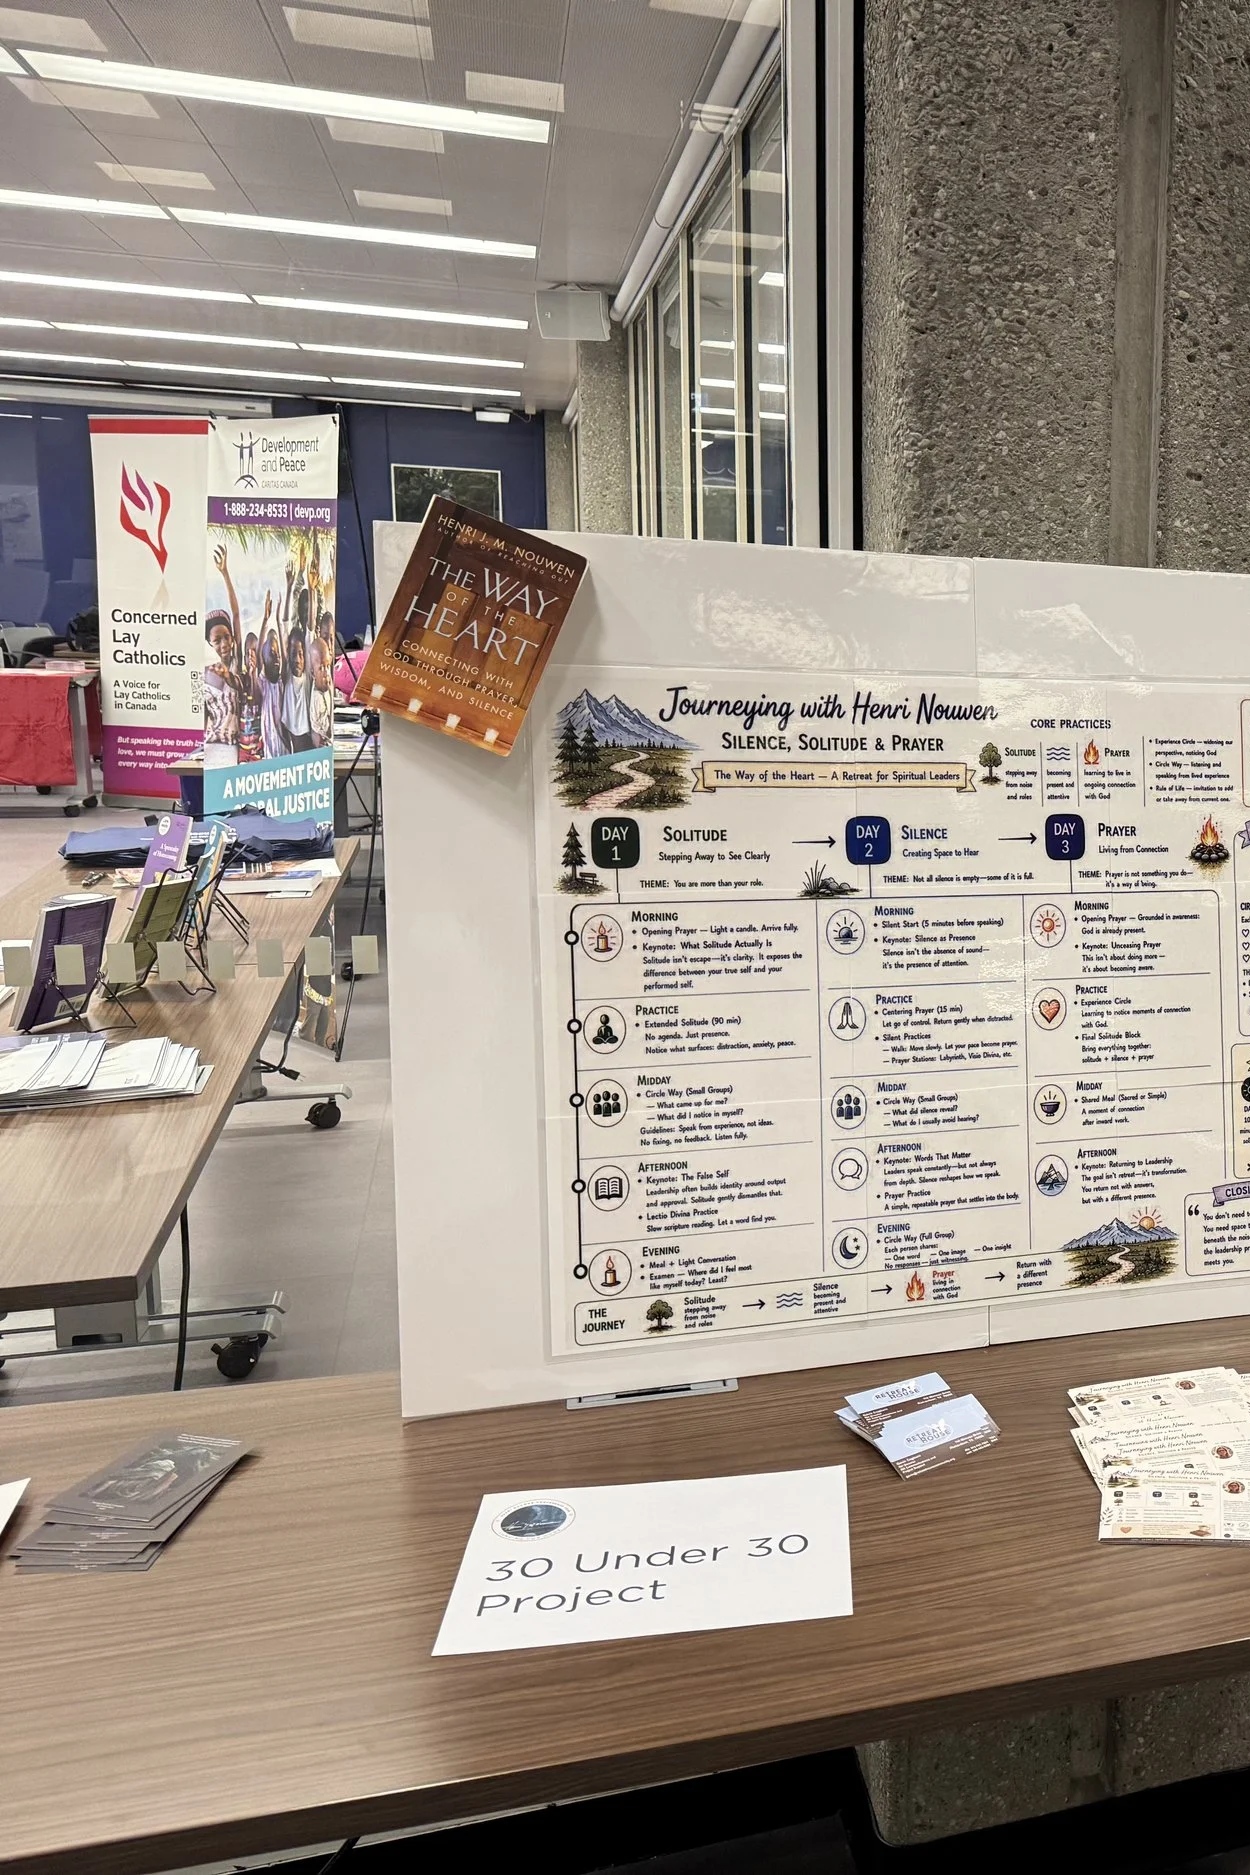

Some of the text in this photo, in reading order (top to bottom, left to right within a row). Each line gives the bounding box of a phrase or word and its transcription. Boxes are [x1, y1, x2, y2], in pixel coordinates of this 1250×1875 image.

[262, 437, 319, 456] Development
[262, 457, 305, 472] and Peace
[224, 503, 330, 522] 1-888-234-8533 devp.org
[438, 514, 575, 578] HENRI J. M. NOUWEN
[438, 528, 474, 545] AUTHOR
[498, 552, 544, 575] REACHING
[552, 574, 569, 584] OUT
[429, 556, 559, 620] THE WAY
[447, 592, 516, 626] OF THE
[112, 609, 197, 625] Concerned
[404, 595, 540, 666] HEART
[113, 629, 140, 647] Lay
[113, 650, 186, 666] Catholics
[402, 639, 514, 689] CONNECTING WITH
[384, 648, 518, 707] GOD THROUGH PRAYER,
[114, 680, 120, 688] A
[148, 681, 160, 689] for
[380, 662, 513, 720] WISDOM, AND SILENCE
[114, 691, 170, 700] Lay Catholics
[126, 702, 157, 711] Canada
[659, 686, 998, 731] Journeying with Henri Nouwen
[1031, 719, 1111, 729] CORE PRACTICES
[131, 738, 162, 747] speaking
[722, 732, 944, 752] SILENCE, SOLITUDE & PRAYER
[118, 748, 133, 756] love,
[1005, 746, 1130, 757] SOLITUDE PRAYER
[223, 759, 330, 798] A MOVEMENT FOR
[715, 770, 960, 782] The Way of the Heart A Retreat for Spiritual Leaders
[282, 788, 329, 813] JUSTICE
[602, 827, 629, 841] DAY
[663, 826, 728, 842] SOLITUDE
[856, 825, 880, 838] DAY
[901, 825, 947, 840] SILENCE
[1054, 823, 1076, 835] DAY
[1098, 823, 1136, 836] PRAYER
[612, 846, 621, 860] 1
[865, 844, 873, 857] 2
[1062, 840, 1070, 853] 3
[1099, 845, 1168, 855] Living from Connection
[659, 852, 692, 863] Stepping
[695, 852, 714, 862] Away
[729, 852, 742, 860] See
[744, 851, 770, 862] Clearly
[903, 849, 931, 859] Creating
[934, 849, 953, 859] Space
[964, 848, 979, 856] Hear
[875, 906, 914, 916] MORNING
[1074, 901, 1109, 912] MORNING
[631, 911, 678, 922] MORNING
[882, 920, 900, 928] Silent
[903, 920, 919, 928] Start
[922, 920, 929, 928] (5
[977, 918, 1004, 927] speaking)
[642, 927, 672, 937] Opening
[675, 927, 697, 936] Prayer
[710, 926, 727, 934] Light
[736, 925, 758, 933] candle.
[761, 924, 781, 932] Arrive
[784, 923, 798, 932] fully.
[643, 943, 676, 952] Keynote:
[703, 941, 732, 949] Solitude
[735, 939, 763, 949] Actually
[766, 939, 772, 947] Is
[1075, 985, 1108, 995] PRACTICE
[876, 994, 912, 1006] PRACTICE
[635, 1005, 679, 1016] PRACTICE
[637, 1075, 671, 1087] MIDDAY
[878, 1082, 907, 1093] MIDDAY
[1076, 1081, 1102, 1092] MIDDAY
[878, 1142, 921, 1154] AFTERNOON
[1078, 1148, 1117, 1159] AFTERNOON
[638, 1160, 688, 1173] AFTERNOON
[877, 1222, 911, 1234] EVENING
[642, 1245, 680, 1257] EVENING
[932, 1269, 955, 1280] Prayer
[813, 1283, 839, 1293] Silence
[684, 1295, 716, 1305] Solitude
[589, 1308, 607, 1319] THE
[583, 1320, 625, 1333] JOURNEY
[485, 1534, 808, 1582] 30 Under 30
[476, 1579, 667, 1617] Project
